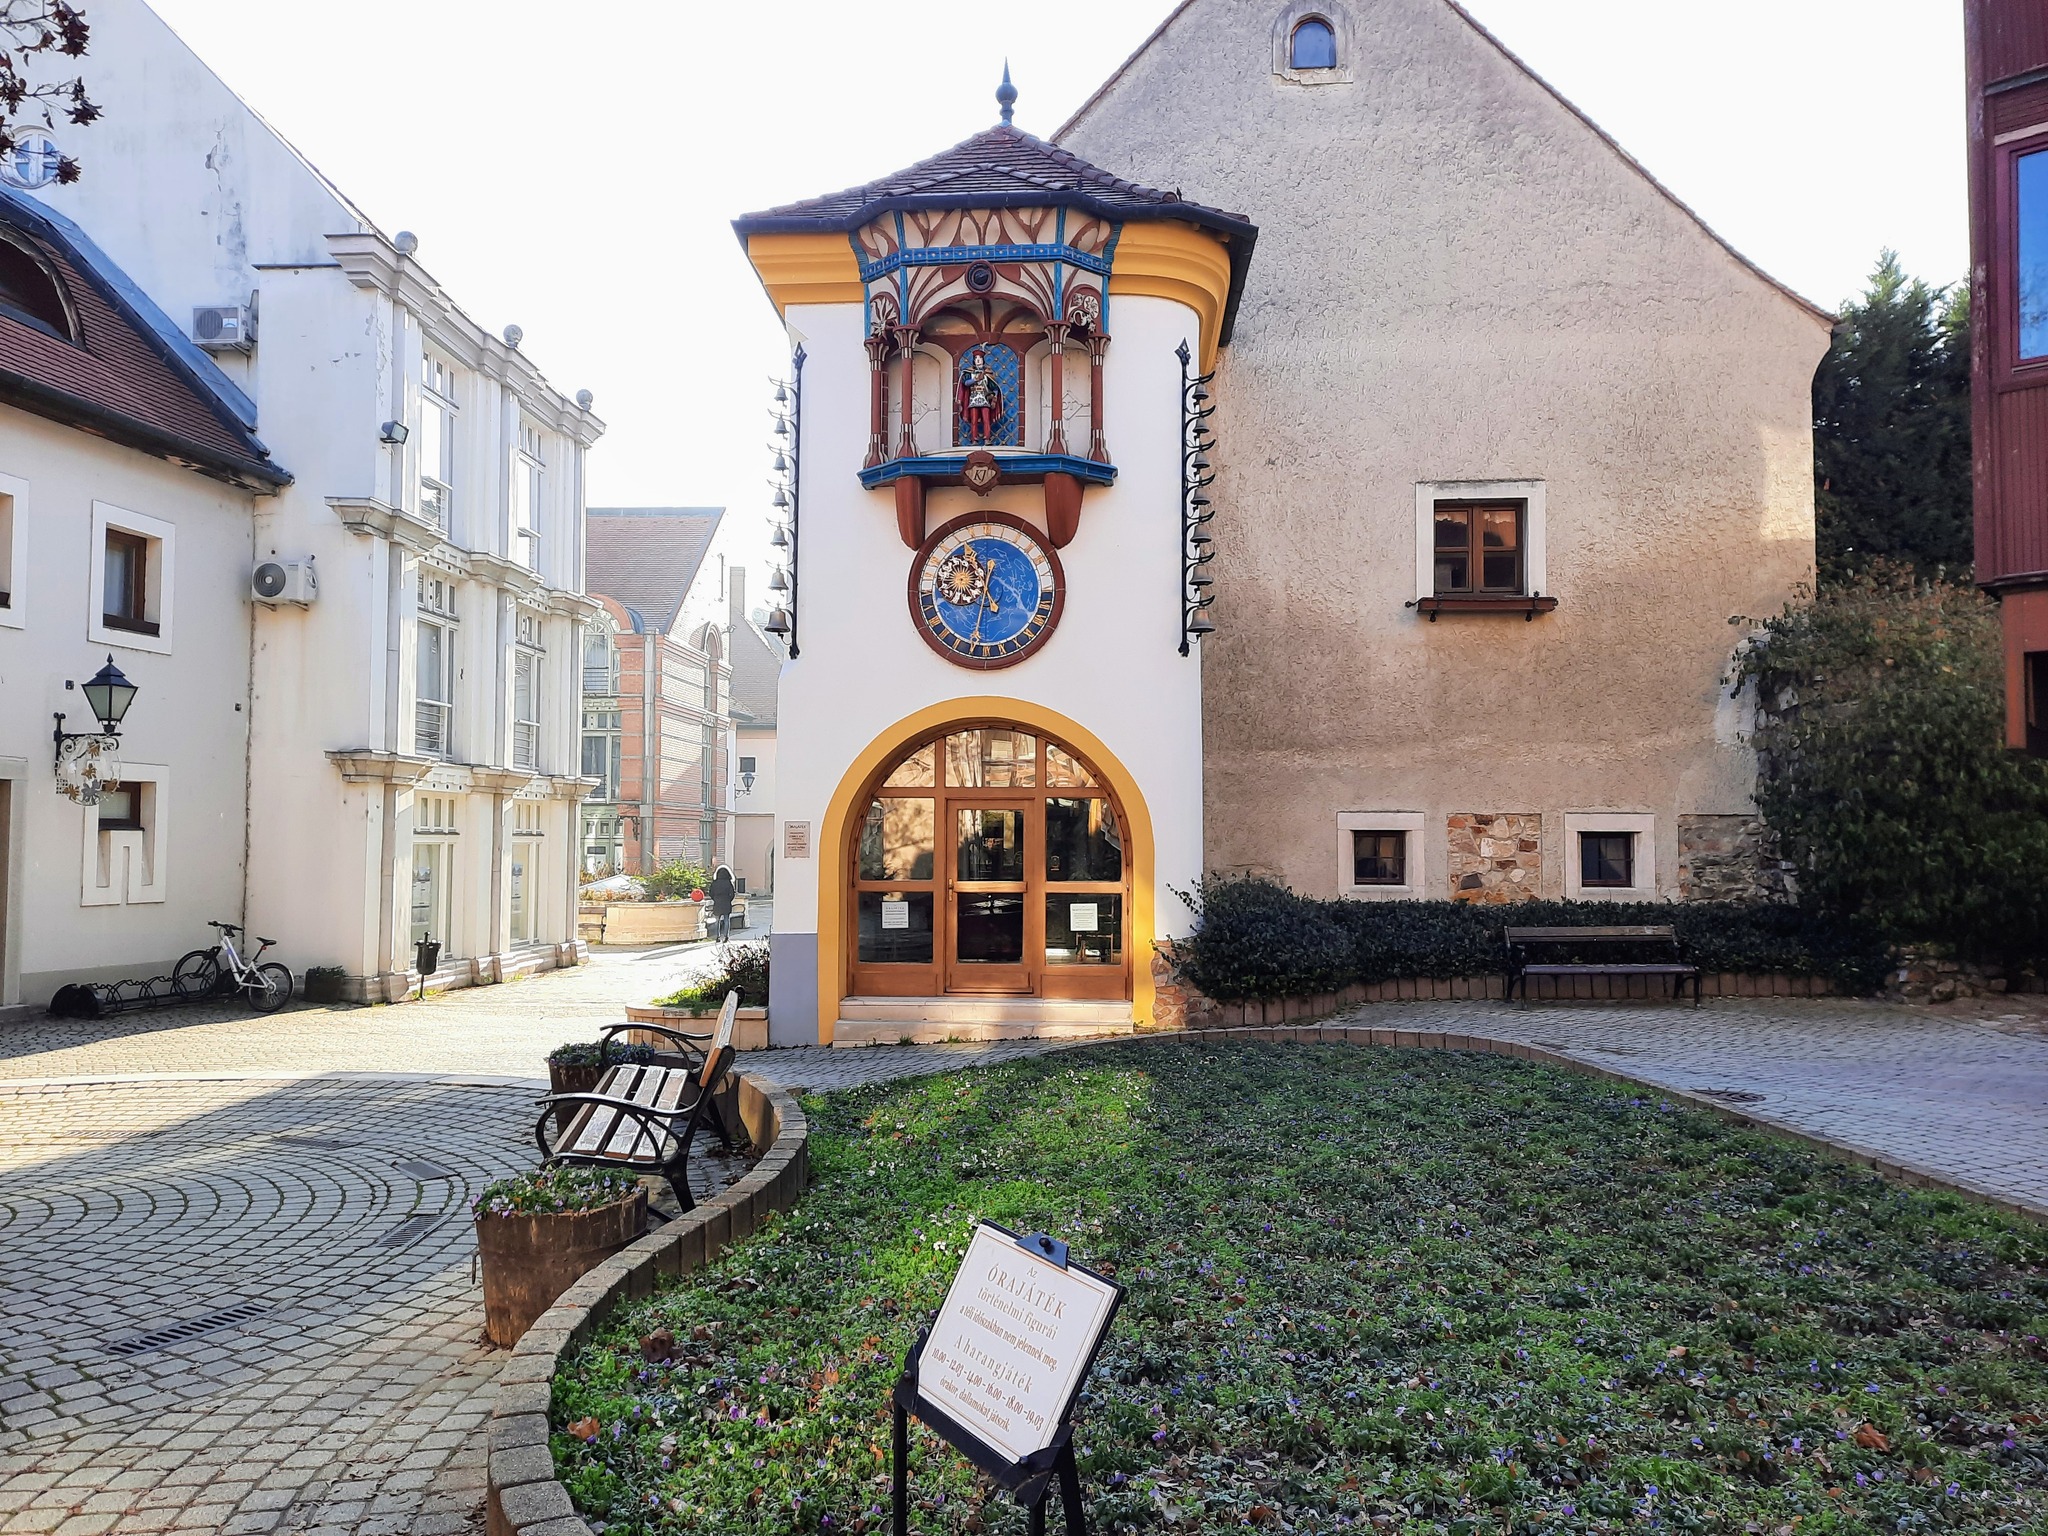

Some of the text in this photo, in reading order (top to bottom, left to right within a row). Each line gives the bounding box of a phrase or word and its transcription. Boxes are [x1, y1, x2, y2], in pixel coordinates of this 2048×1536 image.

[974, 470, 986, 484] KJ
[988, 1262, 1066, 1320] ÓRAJÁTÉK
[1027, 1266, 1038, 1278] Az
[960, 1305, 965, 1315] a
[1002, 1330, 1019, 1346] nem
[1014, 1335, 1044, 1362] jelennek
[978, 1287, 1058, 1340] történelmi figurái
[954, 1334, 1032, 1394] A harangjáték
[959, 1388, 990, 1418] dallamokat
